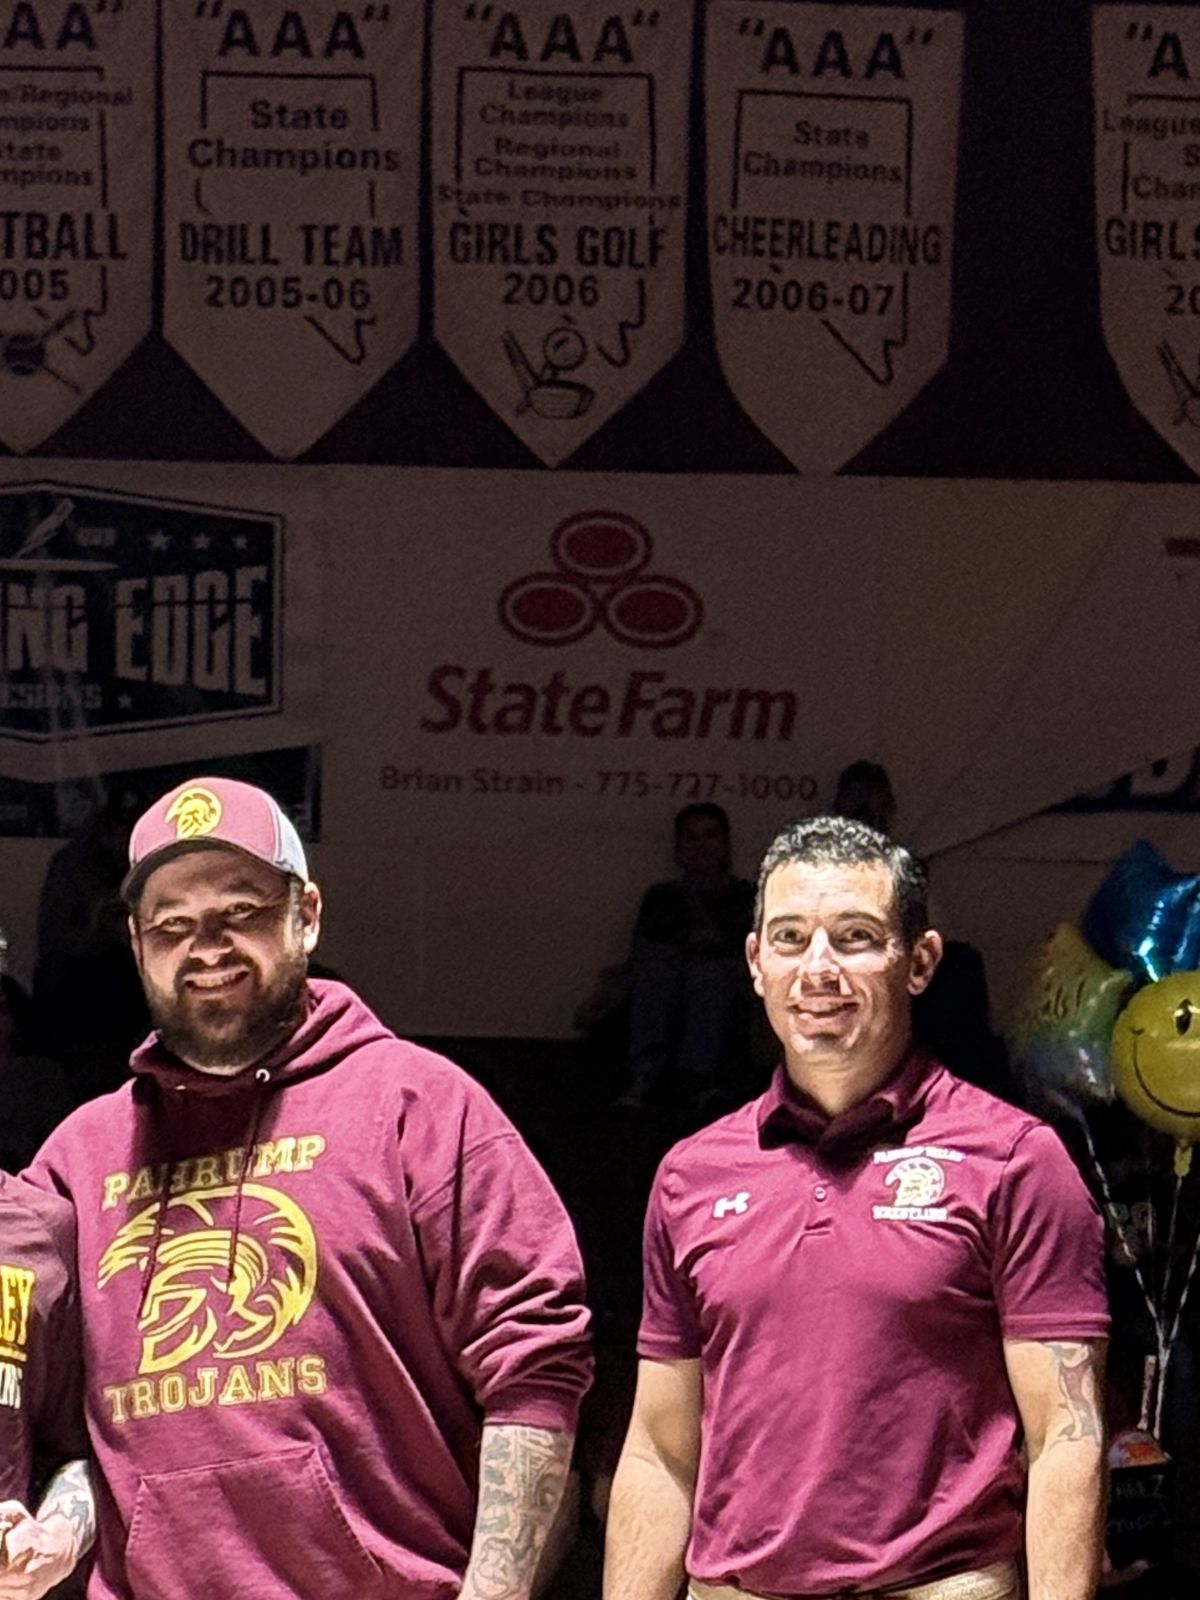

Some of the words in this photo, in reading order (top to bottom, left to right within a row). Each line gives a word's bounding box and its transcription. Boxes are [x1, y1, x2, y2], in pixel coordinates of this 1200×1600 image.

[507, 81, 603, 104] League
[250, 99, 349, 130] State
[480, 103, 629, 130] Champions
[495, 137, 620, 158] Regional
[793, 120, 870, 147] State
[187, 138, 400, 176] Champions
[475, 157, 637, 180] Champions
[743, 151, 902, 184] Champions
[438, 185, 510, 207] State
[522, 189, 682, 210] Champions
[179, 222, 281, 265] DRILL
[301, 224, 403, 267] TEAM
[449, 222, 558, 265] GIRLS
[576, 225, 667, 269] GOLF
[713, 214, 942, 265] CHEERLEADING
[205, 275, 370, 310] 2005-06
[503, 272, 599, 307] 2006
[732, 278, 894, 315] 2006-07
[114, 565, 268, 697] EDGE
[380, 765, 462, 793] Brian
[471, 767, 564, 795] Strain
[596, 771, 819, 800] 775-727-1000
[102, 1134, 326, 1211] PAHRUMP
[104, 1355, 327, 1424] TROJANS
